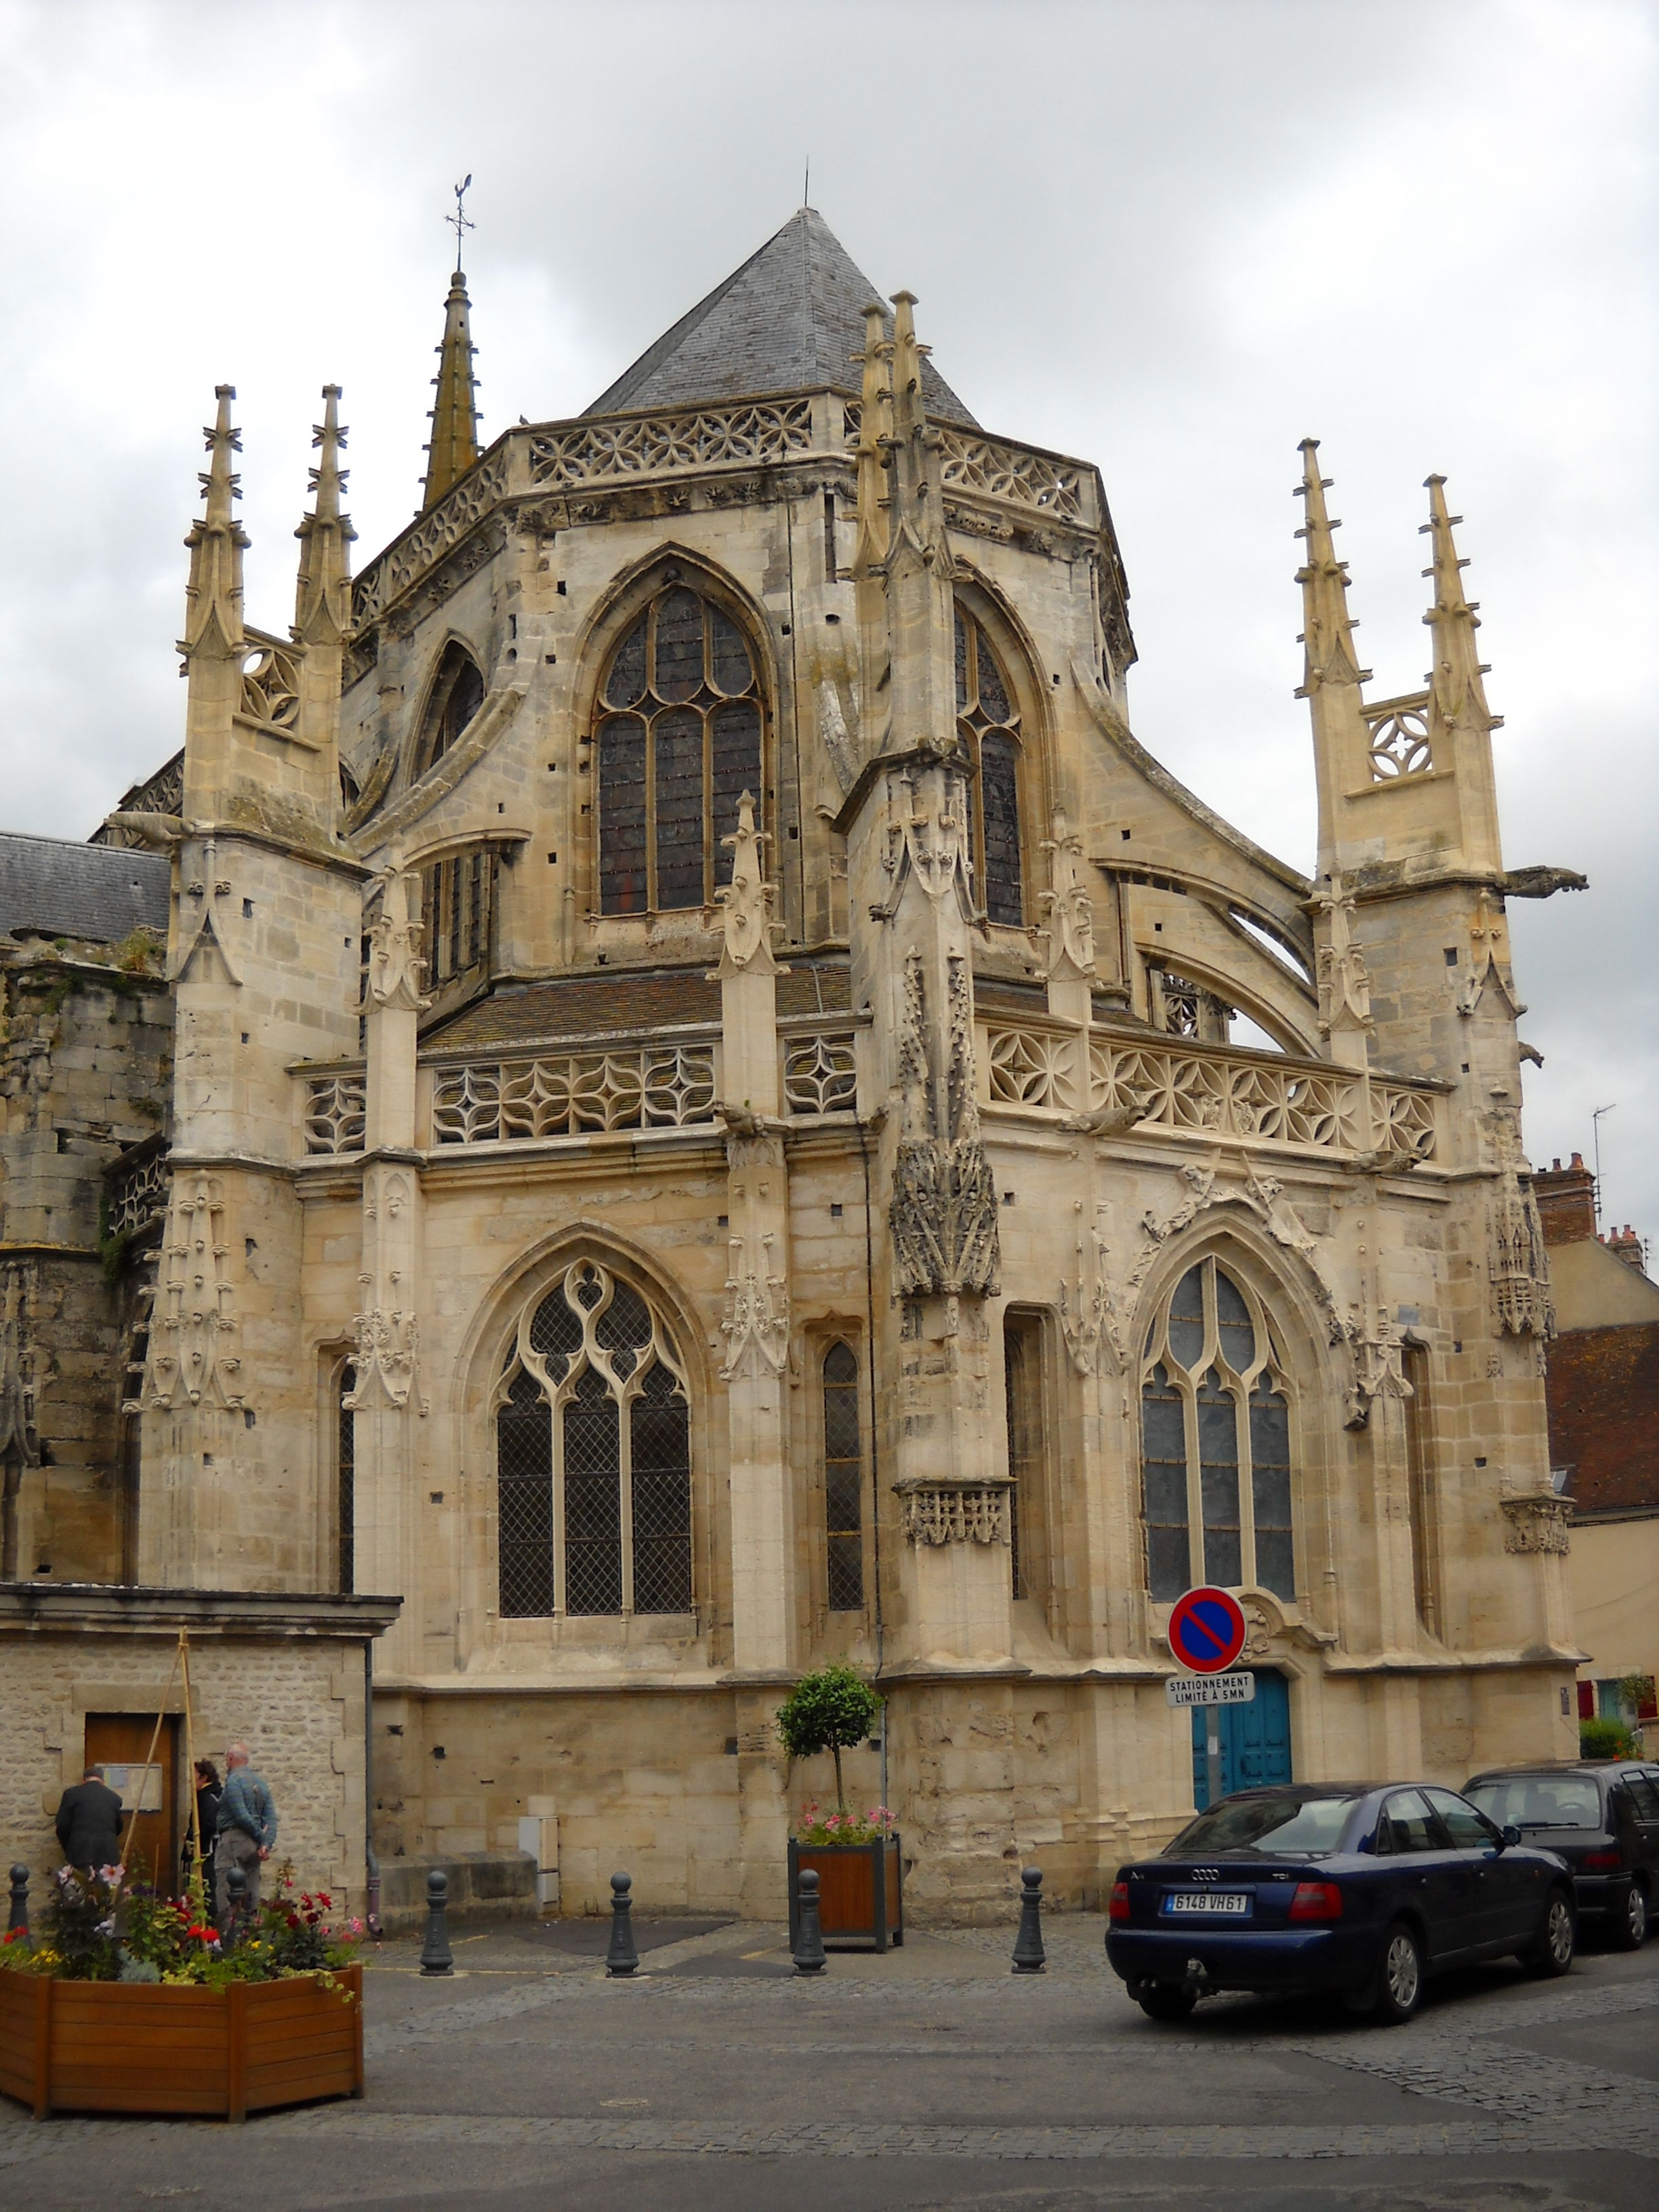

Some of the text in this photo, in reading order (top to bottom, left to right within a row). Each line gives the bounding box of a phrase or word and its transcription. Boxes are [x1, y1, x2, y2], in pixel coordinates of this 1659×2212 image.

[1170, 1677, 1248, 1692] STATIONNEMENT
[1176, 1690, 1207, 1703] LIMITÉ
[1212, 1689, 1218, 1700] À
[1176, 1896, 1206, 1909] 6148
